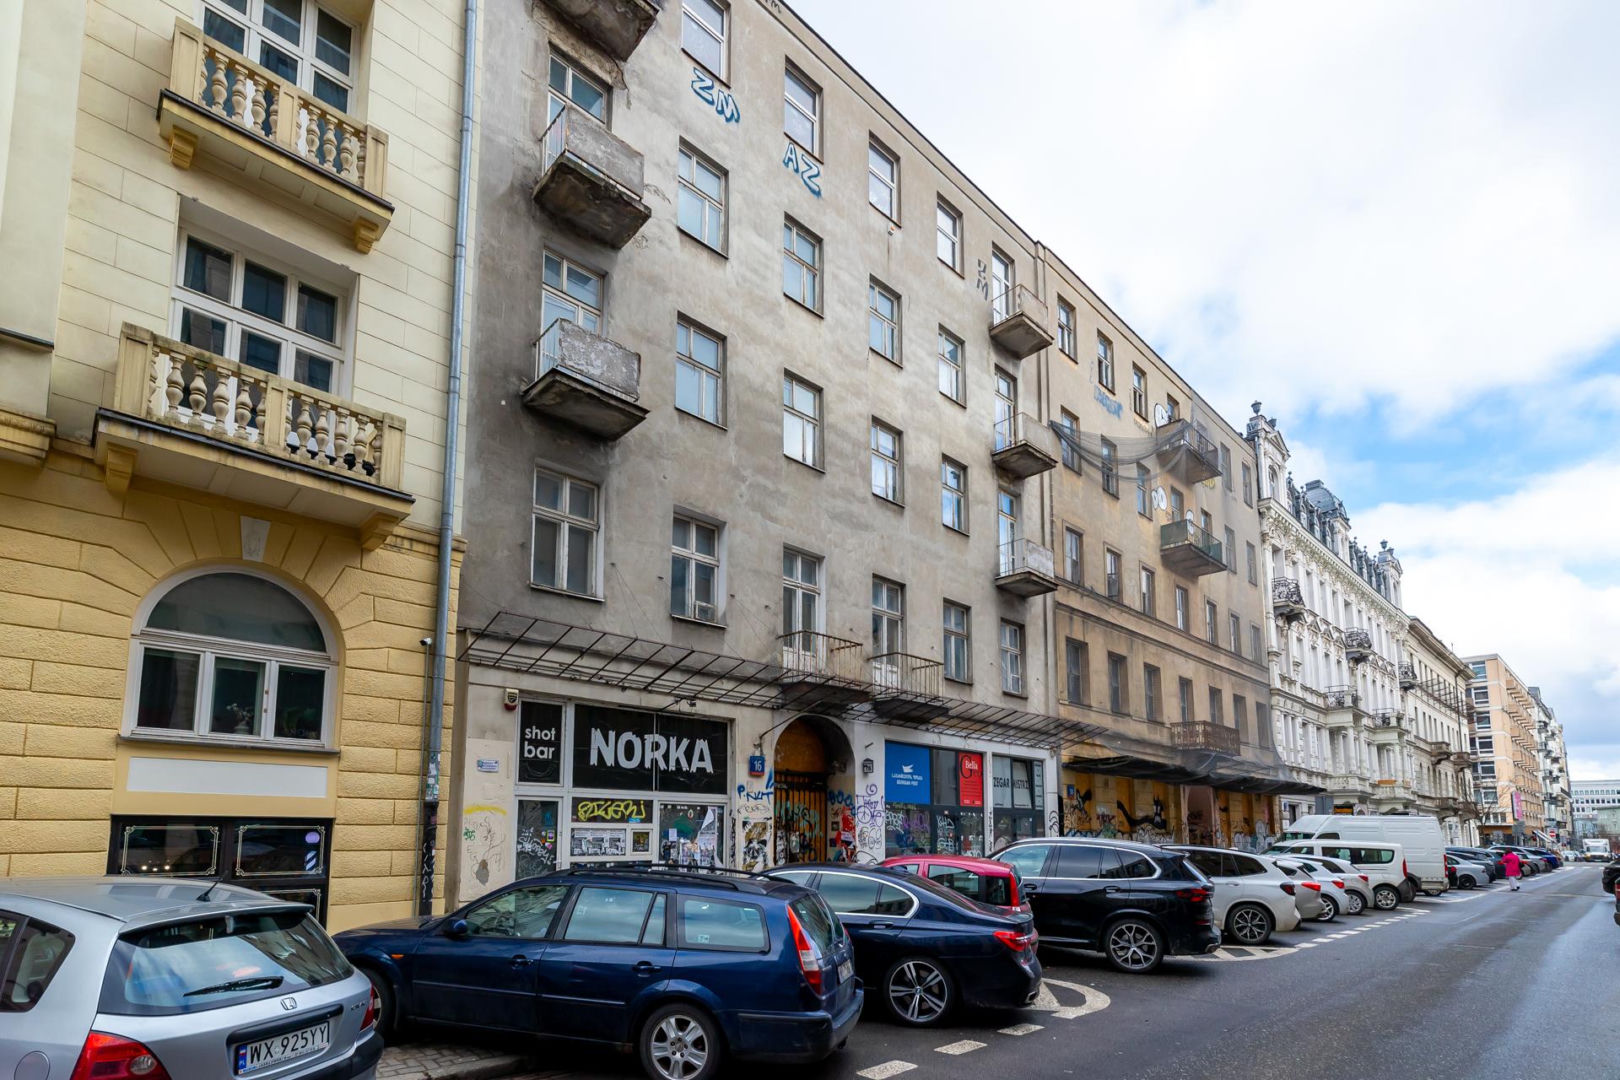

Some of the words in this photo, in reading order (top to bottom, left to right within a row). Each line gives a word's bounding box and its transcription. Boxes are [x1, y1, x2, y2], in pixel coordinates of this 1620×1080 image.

[691, 67, 741, 123] ZM
[783, 143, 822, 198] AZ
[525, 725, 556, 741] shot
[524, 740, 556, 759] bar
[589, 727, 714, 774] NORKA
[753, 760, 763, 772] 16
[965, 760, 979, 770] Bella
[993, 776, 1010, 788] ZEGAR
[250, 1040, 275, 1064] WX
[280, 1025, 327, 1056] 925YY
